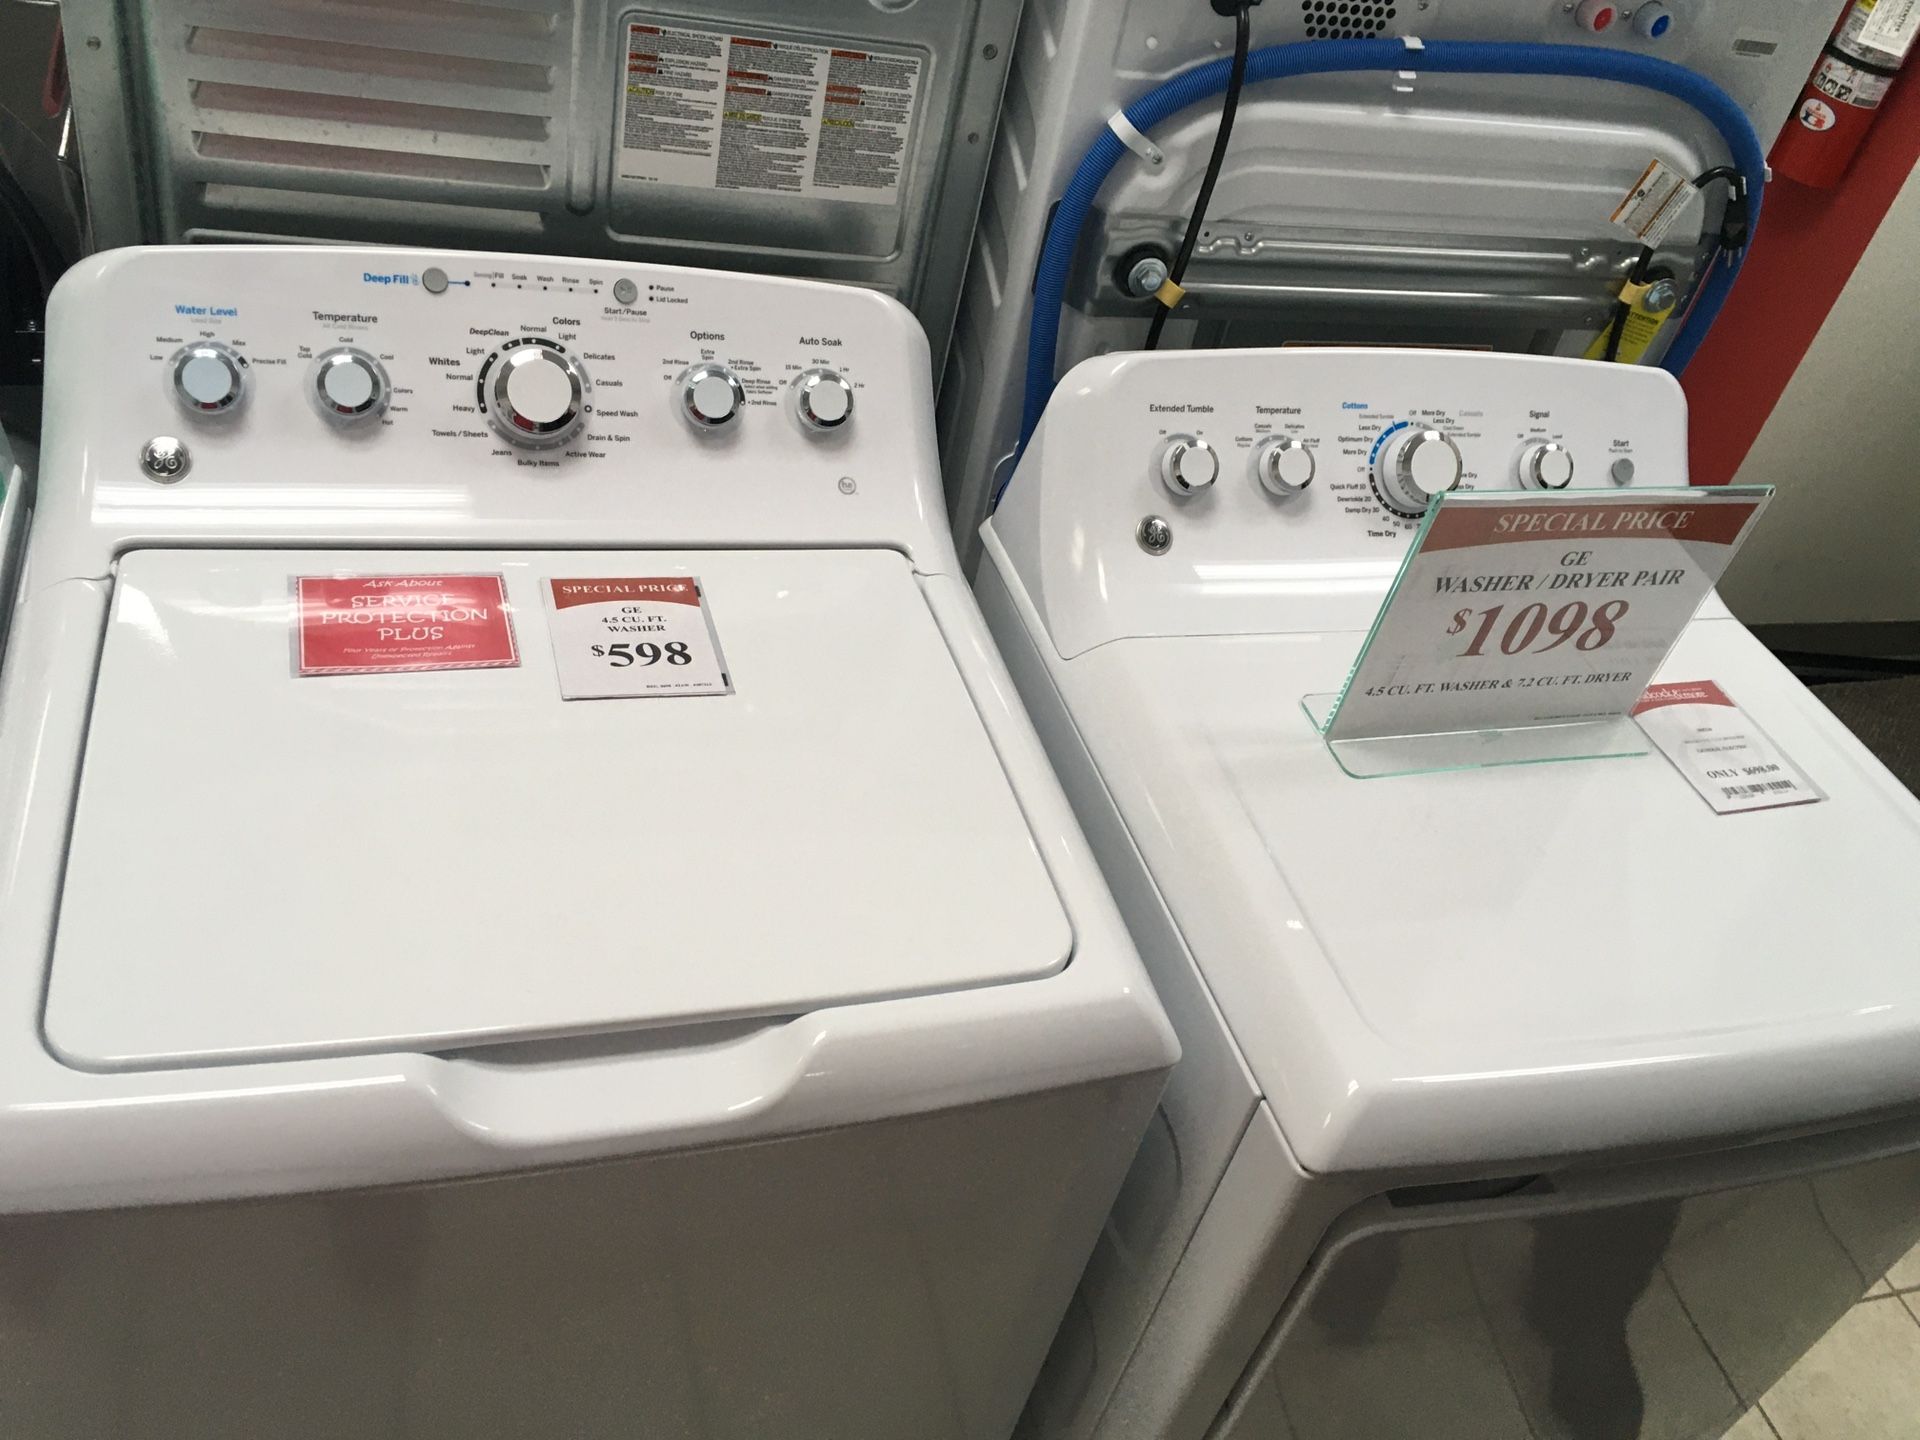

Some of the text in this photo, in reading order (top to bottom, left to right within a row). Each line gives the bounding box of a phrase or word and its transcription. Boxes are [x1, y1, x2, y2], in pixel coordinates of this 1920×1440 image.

[363, 272, 409, 285] Deep Fill
[562, 276, 580, 284] Rinse
[175, 304, 238, 317] Water Level
[312, 311, 378, 324] Temperature
[552, 316, 581, 327] Colors
[469, 327, 510, 337] DeepClean
[520, 324, 548, 333] Normal
[558, 333, 577, 341] Light
[690, 330, 725, 342] Options
[799, 336, 842, 347] Auto Soak
[466, 347, 485, 356] Light
[252, 357, 287, 366] Precise Fill
[429, 357, 461, 367] Whites
[583, 353, 616, 361] Delicates
[445, 373, 474, 382] Normal
[595, 379, 624, 387] Casuals
[452, 405, 476, 414] Heavy
[1149, 405, 1214, 414] Extended Tumble
[1256, 406, 1302, 415] Temperature
[1342, 402, 1368, 410] Cottons
[596, 410, 638, 419] Speed Wash
[1529, 410, 1550, 420] Signal
[431, 429, 457, 438] Towels
[462, 430, 489, 439] Sheets
[587, 434, 606, 442] Drain
[614, 435, 630, 443] Spin
[1338, 435, 1374, 444] Optimum Dry
[1613, 439, 1629, 447] Start
[565, 451, 606, 459] Active Wear
[517, 459, 560, 468] Bulky Items
[1493, 510, 1695, 533] SPECIAL PRICE
[1384, 530, 1397, 538] Dry
[1560, 550, 1592, 567] GE
[363, 580, 443, 588] Ask About
[1434, 574, 1535, 594] WASHER
[1548, 571, 1630, 590] DRYER
[1632, 569, 1686, 586] PAIR
[562, 584, 688, 594] SPECIAL PRICE
[351, 594, 454, 609] SERVICE
[322, 608, 488, 624] PROTECTION
[377, 626, 444, 641] PLUS
[1446, 599, 1630, 658] $1098
[591, 641, 692, 668] $598
[1365, 672, 1632, 697] 4.5 CU. FT. WASHER & 7.2 CU. FT. DRYER
[1706, 768, 1739, 779] ONLY
